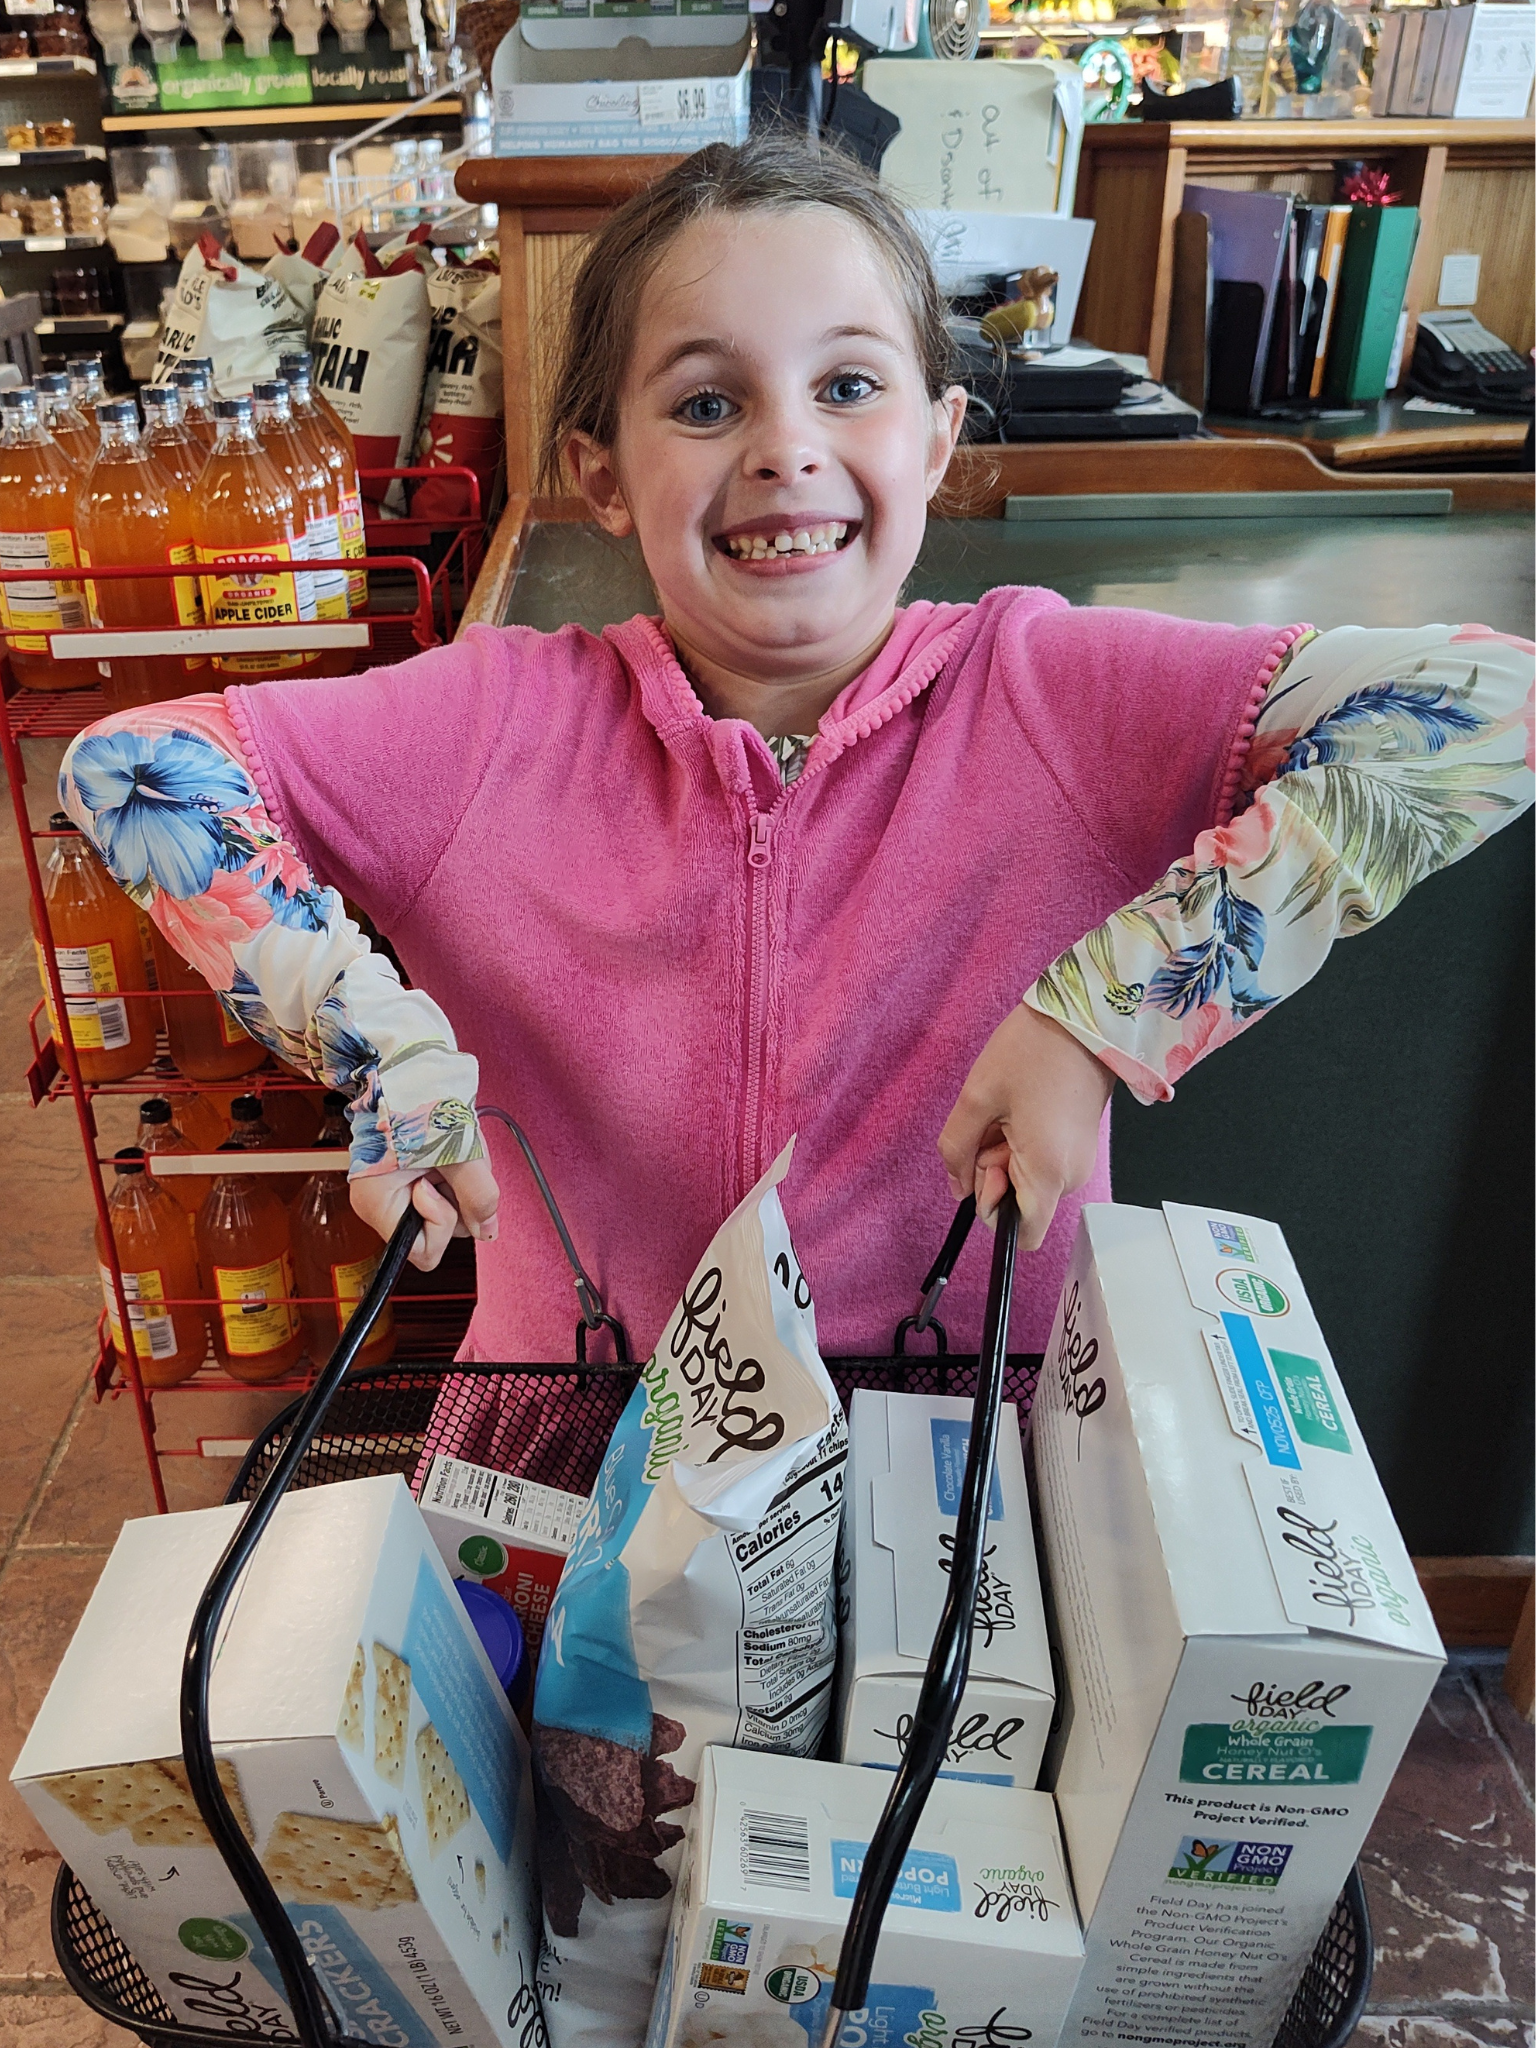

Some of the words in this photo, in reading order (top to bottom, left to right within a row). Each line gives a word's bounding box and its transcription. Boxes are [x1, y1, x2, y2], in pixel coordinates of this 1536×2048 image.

[161, 71, 250, 99] organically
[254, 72, 308, 96] grown
[312, 66, 366, 91] locally
[214, 608, 251, 622] APPLE
[254, 603, 294, 620] CIDER
[1210, 1222, 1221, 1238] NON
[1219, 1223, 1230, 1240] GMO
[1235, 1227, 1253, 1260] VERIFIED
[1232, 1278, 1254, 1303] USDA
[1251, 1277, 1274, 1312] ORGANIC
[671, 1267, 785, 1463] field
[680, 1345, 718, 1428] DAY
[1306, 1374, 1338, 1432] CEREAL
[816, 1407, 845, 1452] Facts
[828, 1437, 849, 1453] chips
[938, 1434, 951, 1461] Vanilla
[440, 1460, 453, 1476] Facts
[941, 1460, 956, 1502] Chocolate
[1282, 1484, 1296, 1503] BEST
[1293, 1485, 1306, 1506] USED
[758, 1518, 769, 1530] per
[769, 1502, 791, 1521] serving
[735, 1510, 801, 1563] Calories
[1276, 1506, 1376, 1627] field
[1338, 1547, 1373, 1598] DAY
[747, 1575, 770, 1596] Total
[770, 1567, 785, 1581] Fat
[761, 1573, 794, 1603] Saturated
[795, 1566, 807, 1580] Fat
[1351, 1534, 1411, 1627] organic
[784, 1588, 796, 1602] Fat
[991, 1572, 1015, 1620] DAY
[525, 1583, 551, 1645] CHEESE
[743, 1640, 786, 1652] Sodium
[787, 1634, 812, 1647] 80mg
[760, 1671, 779, 1690] Total
[768, 1674, 796, 1700] Includes
[1230, 1680, 1352, 1718] field
[745, 1711, 781, 1732] Vitamin
[781, 1719, 788, 1730] D
[788, 1706, 809, 1725] 0mcg
[1258, 1706, 1304, 1720] DAY
[743, 1722, 781, 1742] Calcium
[782, 1724, 805, 1740] 30mg
[873, 1713, 1025, 1761] fld
[1232, 1718, 1320, 1737] organic
[740, 1736, 761, 1748] Iron
[1228, 1735, 1271, 1748] Whole
[1274, 1736, 1314, 1748] Grain
[1216, 1747, 1263, 1758] Honey
[1267, 1747, 1295, 1757] Nut
[1202, 1763, 1330, 1780] CEREAL
[1164, 1793, 1195, 1806] This
[1197, 1798, 1256, 1813] product
[1259, 1802, 1271, 1813] is
[1274, 1804, 1350, 1818] Non-GMO
[1193, 1810, 1246, 1825] Project
[1249, 1815, 1310, 1829] Verified.
[1241, 1844, 1287, 1857] NON
[1232, 1863, 1280, 1875] Project
[1236, 1855, 1285, 1867] GMO
[980, 1865, 1045, 1883] organic
[1176, 1868, 1276, 1886] VERIFIED
[923, 1884, 950, 1899] Light
[1000, 1881, 1032, 1896] DAY
[973, 1882, 1060, 1922] field
[1151, 1895, 1184, 1907] Field
[1187, 1899, 1213, 1911] Day
[1216, 1902, 1239, 1912] has
[1240, 1904, 1286, 1915] joined
[1136, 1906, 1158, 1916] the
[1161, 1909, 1231, 1923] Non-GMO
[1144, 1919, 1195, 1932] Product
[1199, 1925, 1272, 1937] Verification
[398, 1936, 419, 1960] 453g
[709, 1920, 727, 1961] VERIFIED
[1110, 1939, 1152, 1951] Whole
[1155, 1945, 1191, 1955] Grain
[1194, 1948, 1239, 1961] Honey
[1239, 1951, 1264, 1961] Nut
[1193, 1936, 1220, 1946] Our
[1222, 1938, 1276, 1950] Organic
[727, 1943, 739, 1962] GMO
[736, 1944, 748, 1965] NON
[1129, 1953, 1173, 1965] Cereal
[1175, 1958, 1186, 1966] is
[1188, 1959, 1226, 1970] made
[1229, 1962, 1259, 1972] from
[299, 1919, 410, 2048] CRACKERS
[778, 1970, 791, 1997] ORGANIC
[1116, 1965, 1159, 1977] simple
[1162, 1969, 1236, 1983] ingredients
[1238, 1975, 1264, 1984] that
[421, 1980, 439, 1996] OZ
[792, 1975, 809, 1997] USDA
[1096, 1985, 1119, 1996] use
[1122, 1987, 1136, 1996] of
[1138, 1990, 1207, 2003] prohibited
[1115, 1976, 1136, 1985] are
[1139, 1979, 1181, 1991] grown
[1183, 1982, 1231, 1993] without
[1234, 1986, 1256, 1995] the
[168, 1971, 262, 2034] eld
[430, 1992, 445, 2006] 16
[1104, 1997, 1162, 2012] fertilizers
[1164, 2004, 1180, 2012] or
[434, 2004, 454, 2021] WT
[1106, 2008, 1129, 2018] For
[1141, 2013, 1202, 2025] complete
[1204, 2017, 1224, 2026] list
[1225, 2018, 1241, 2027] of
[440, 2014, 464, 2035] NET
[868, 2006, 895, 2044] Light
[1080, 2028, 1100, 2038] go
[1101, 2030, 1115, 2039] to
[1082, 2016, 1116, 2028] Field
[1117, 2020, 1142, 2033] Day
[1144, 2024, 1193, 2036] verified
